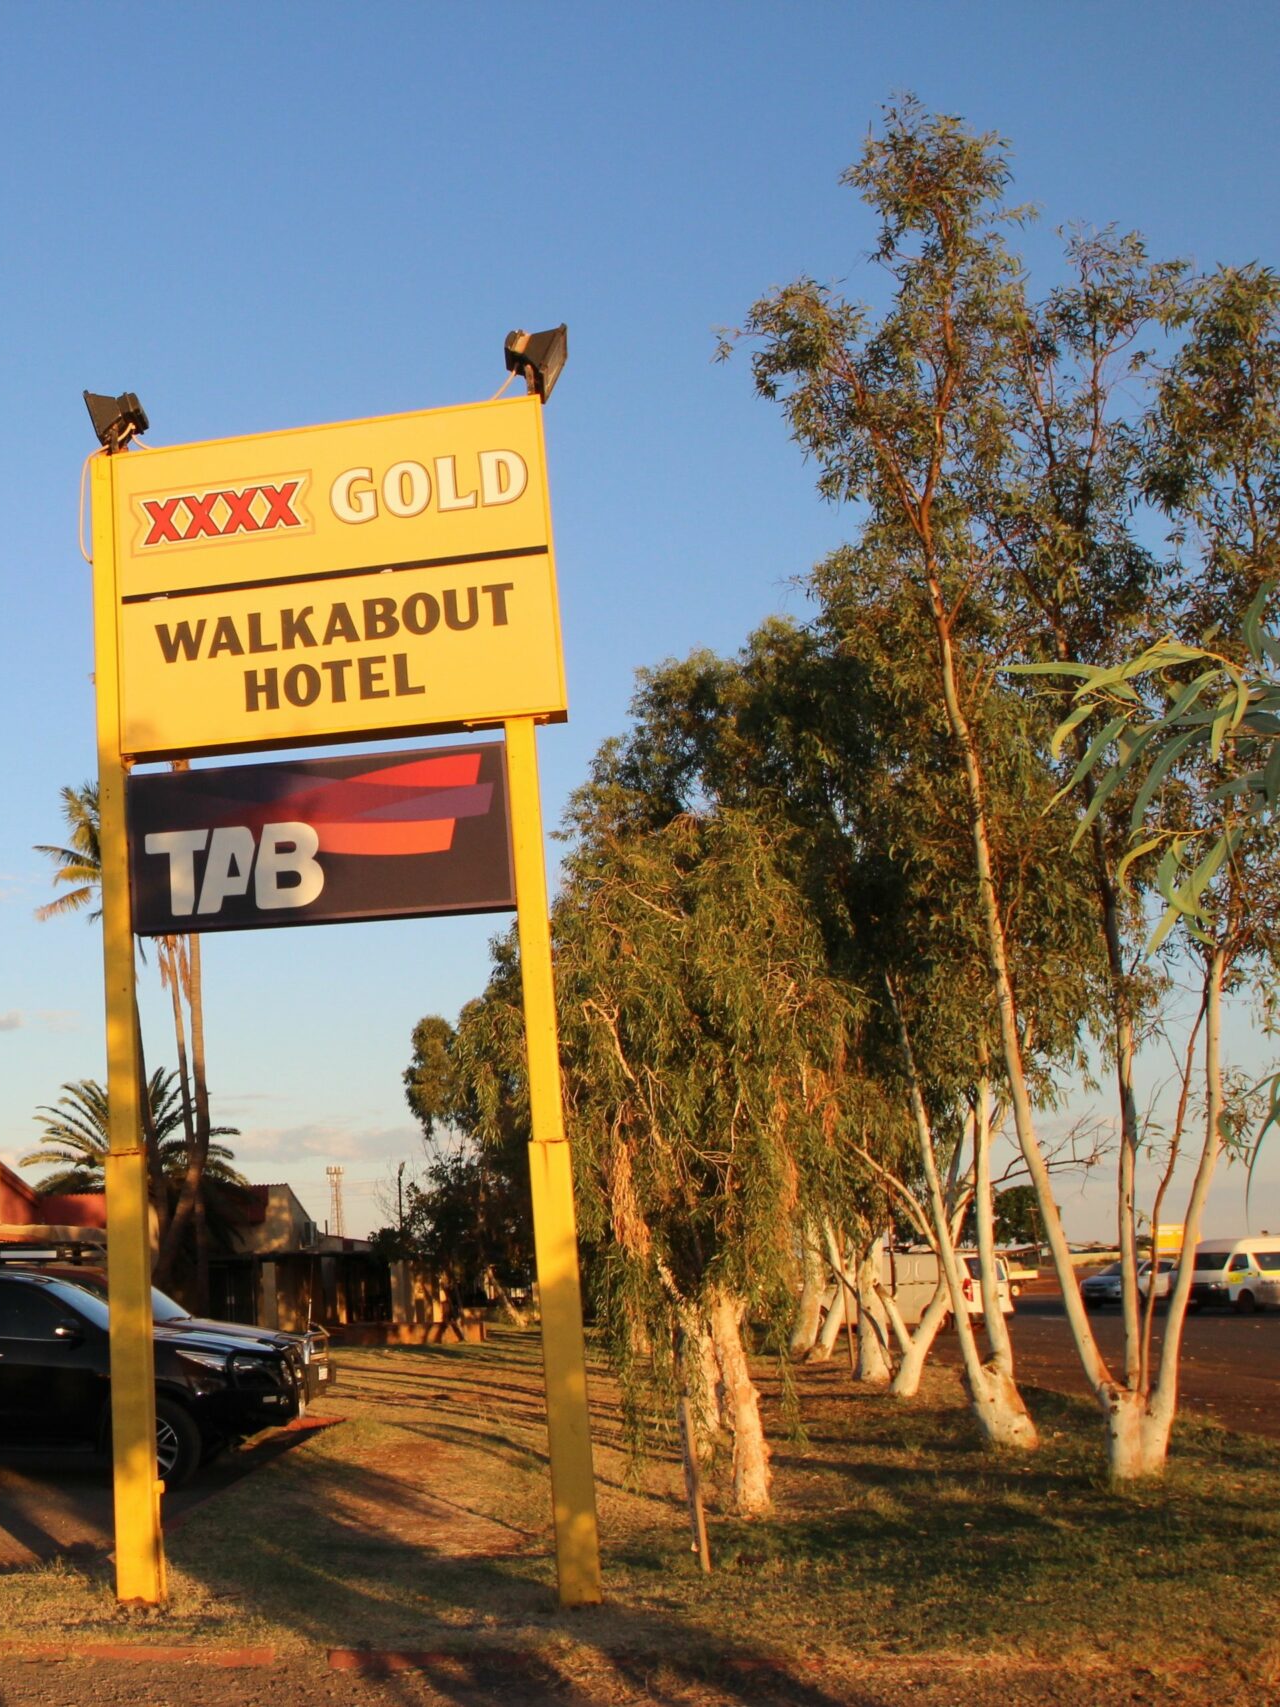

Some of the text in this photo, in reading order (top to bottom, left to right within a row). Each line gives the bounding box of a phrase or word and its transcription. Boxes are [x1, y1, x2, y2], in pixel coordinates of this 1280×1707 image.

[142, 448, 529, 548] XXXX GOLD
[154, 582, 515, 664] WALKABOUT
[243, 652, 426, 713] HOTEL
[144, 821, 325, 917] TAB
